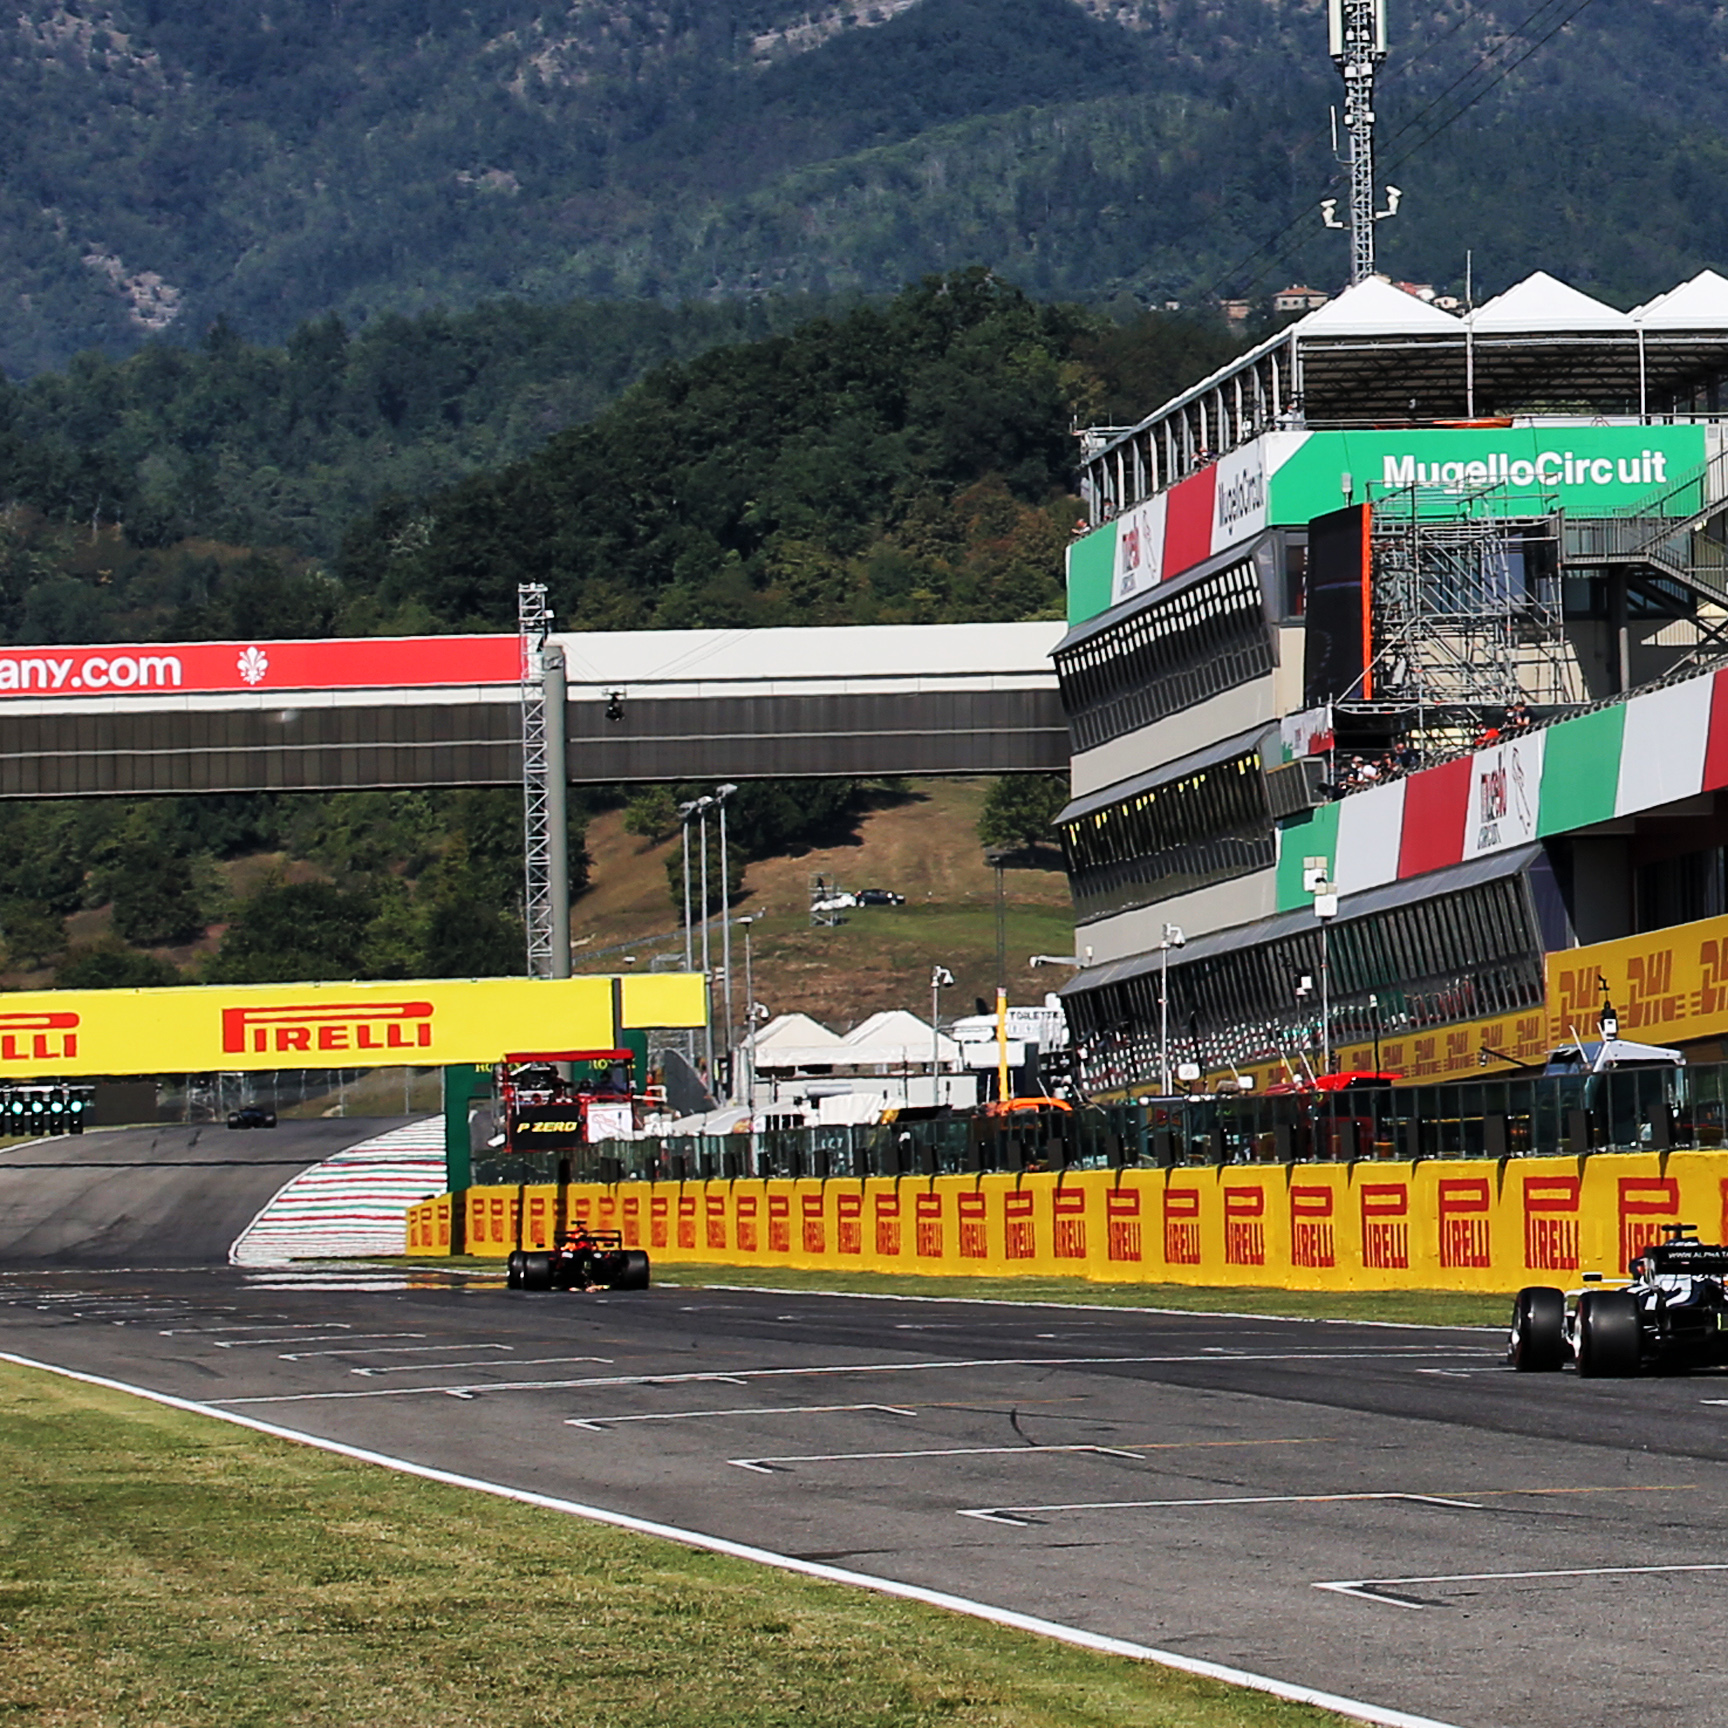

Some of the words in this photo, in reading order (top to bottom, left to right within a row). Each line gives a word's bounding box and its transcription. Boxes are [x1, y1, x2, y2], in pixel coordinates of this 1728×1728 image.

[1382, 449, 1668, 495] MugelloCircuit
[222, 1002, 434, 1053] PIRELLI
[1628, 950, 1676, 1029] DHL
[531, 1121, 578, 1133] ZERO
[1163, 1188, 1201, 1265] PIRELLI
[1224, 1185, 1265, 1266] PIRELLI
[1290, 1185, 1336, 1268] PIRELLI
[1361, 1183, 1409, 1269] PIRELLI
[1438, 1177, 1491, 1268] PIRELLI
[1523, 1175, 1580, 1270] PIRELLI
